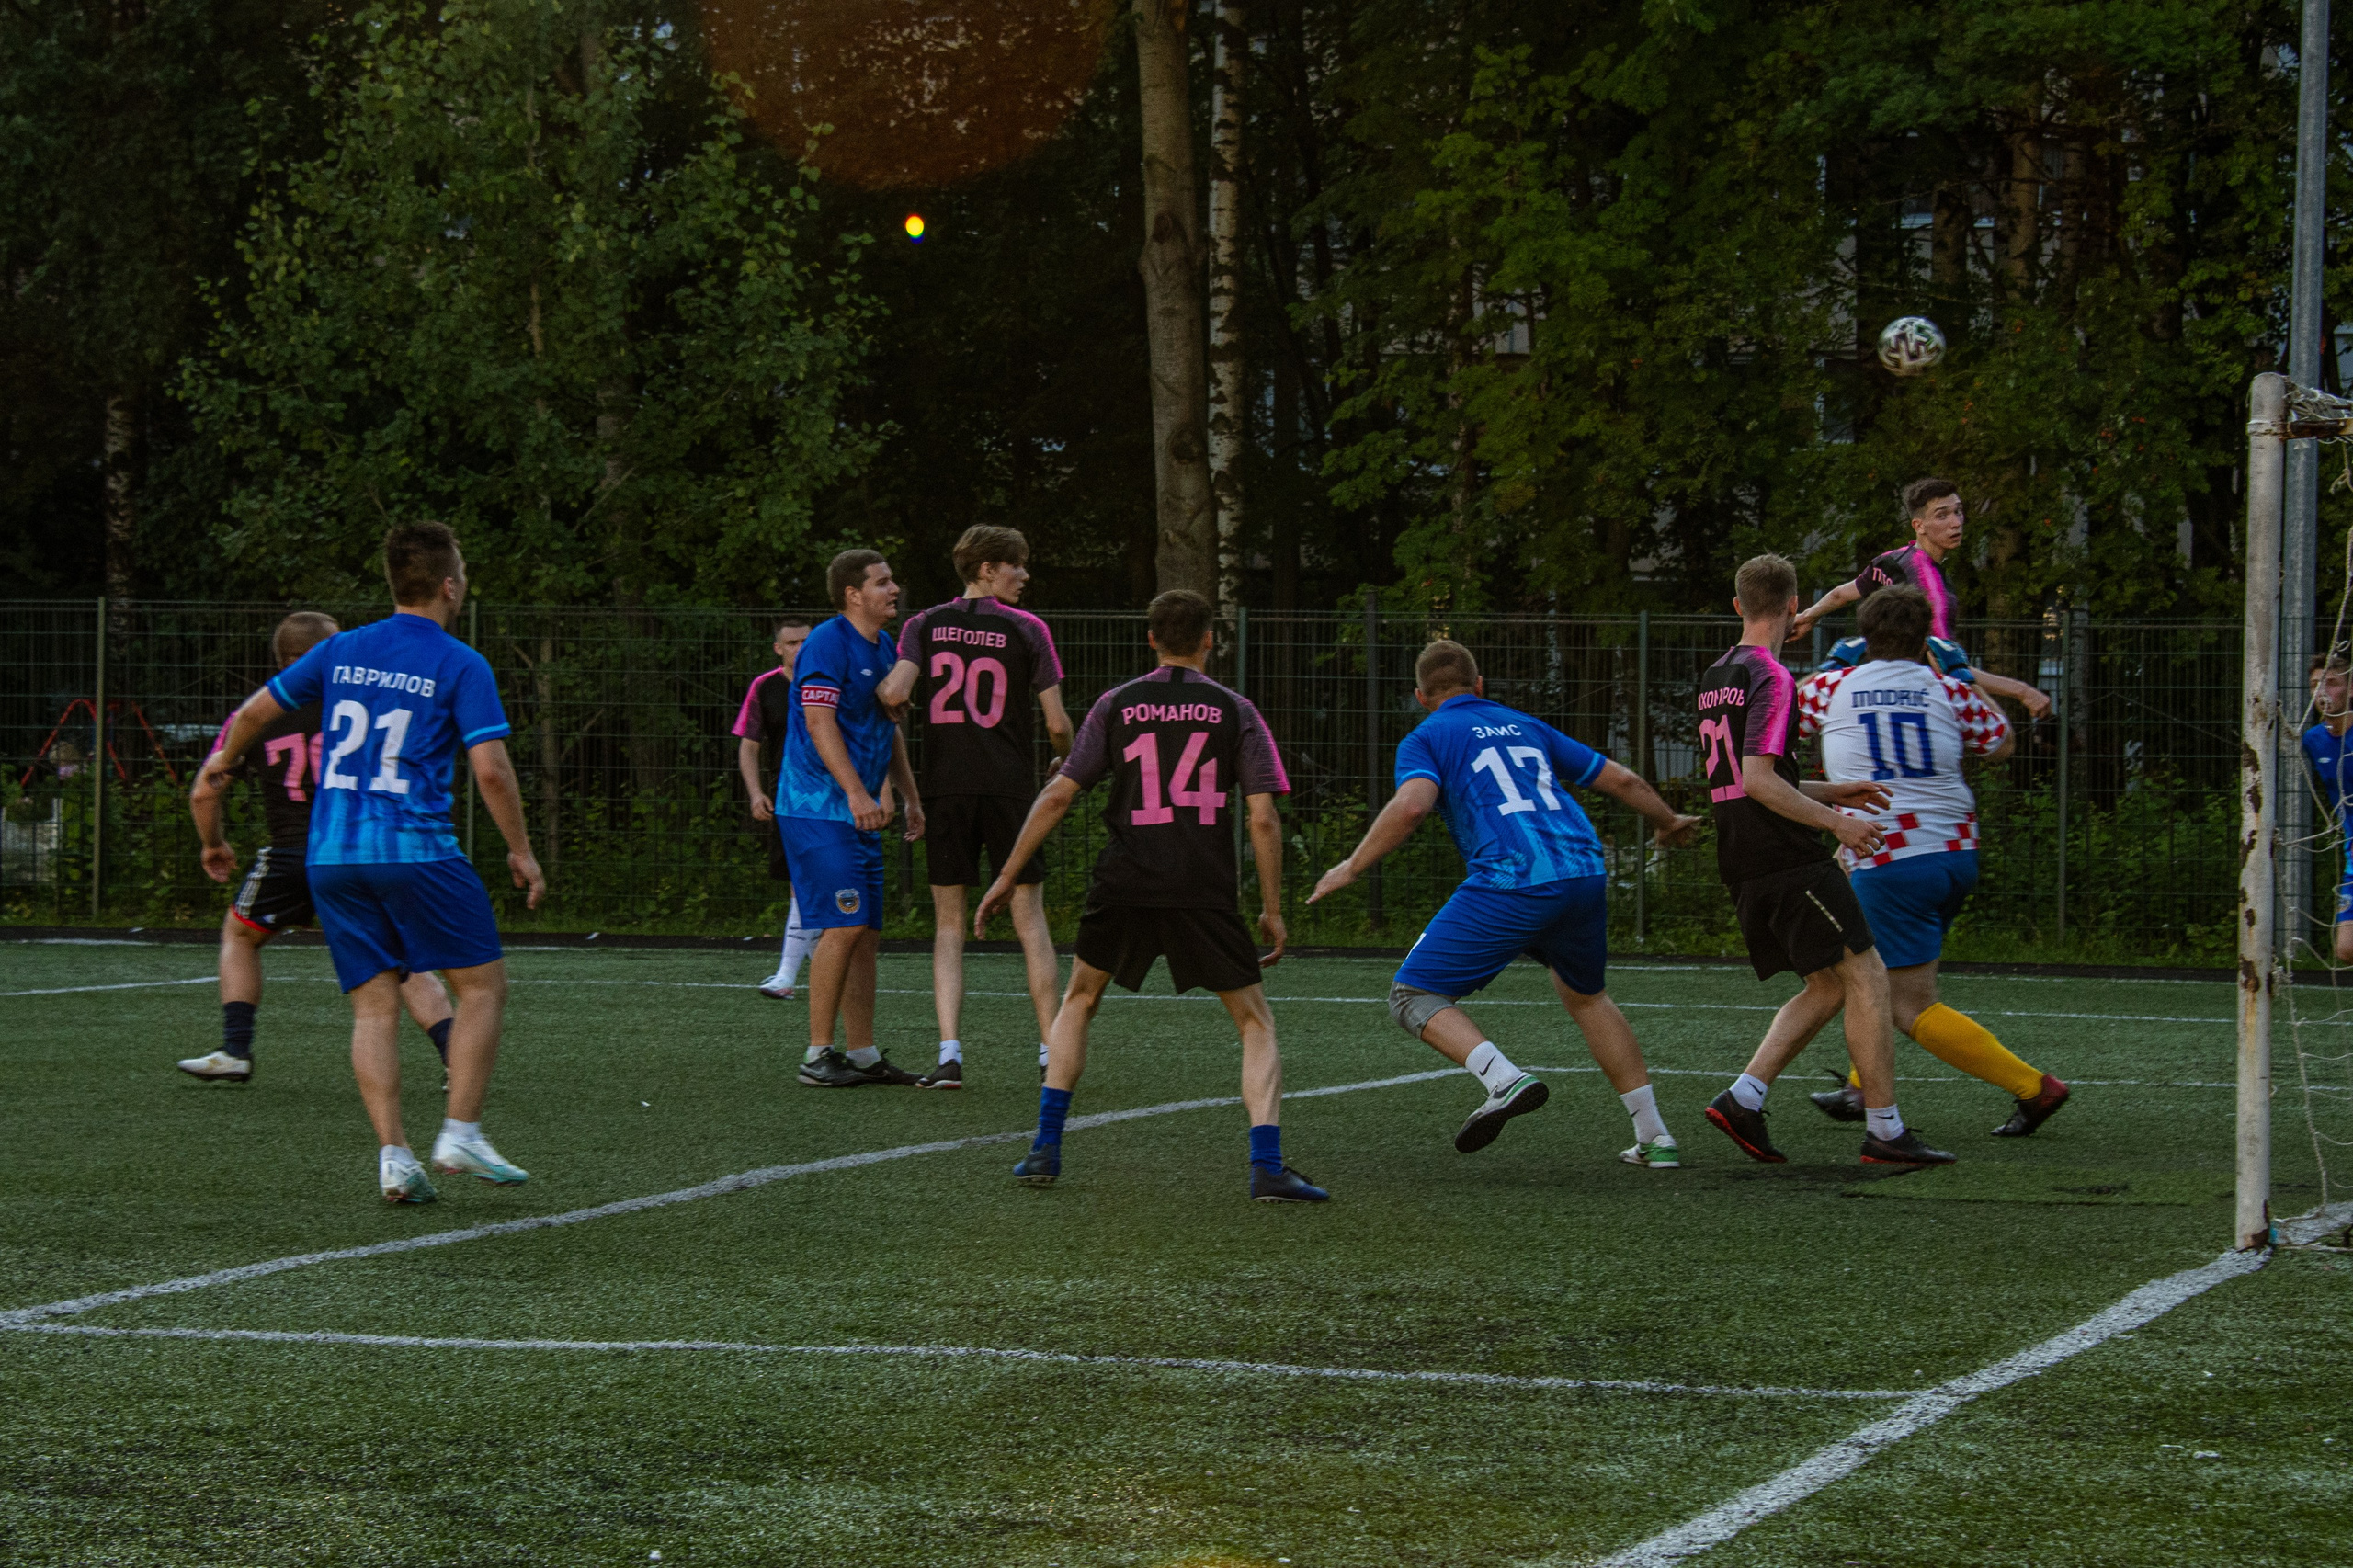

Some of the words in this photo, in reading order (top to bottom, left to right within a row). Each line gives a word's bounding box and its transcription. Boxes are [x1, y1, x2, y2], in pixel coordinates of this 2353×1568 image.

[931, 626, 1007, 648] ЩЕГОЛЕВ
[332, 665, 436, 698] ГАВРИЛОВ
[929, 651, 1008, 729] 20
[1121, 703, 1222, 725] РОМАНОВ
[323, 699, 413, 795] 21
[1472, 724, 1522, 739] ЗАИС
[1699, 714, 1747, 804] 21
[1857, 712, 1937, 781] 10
[1122, 732, 1227, 826] 14
[1471, 745, 1562, 816] 17
